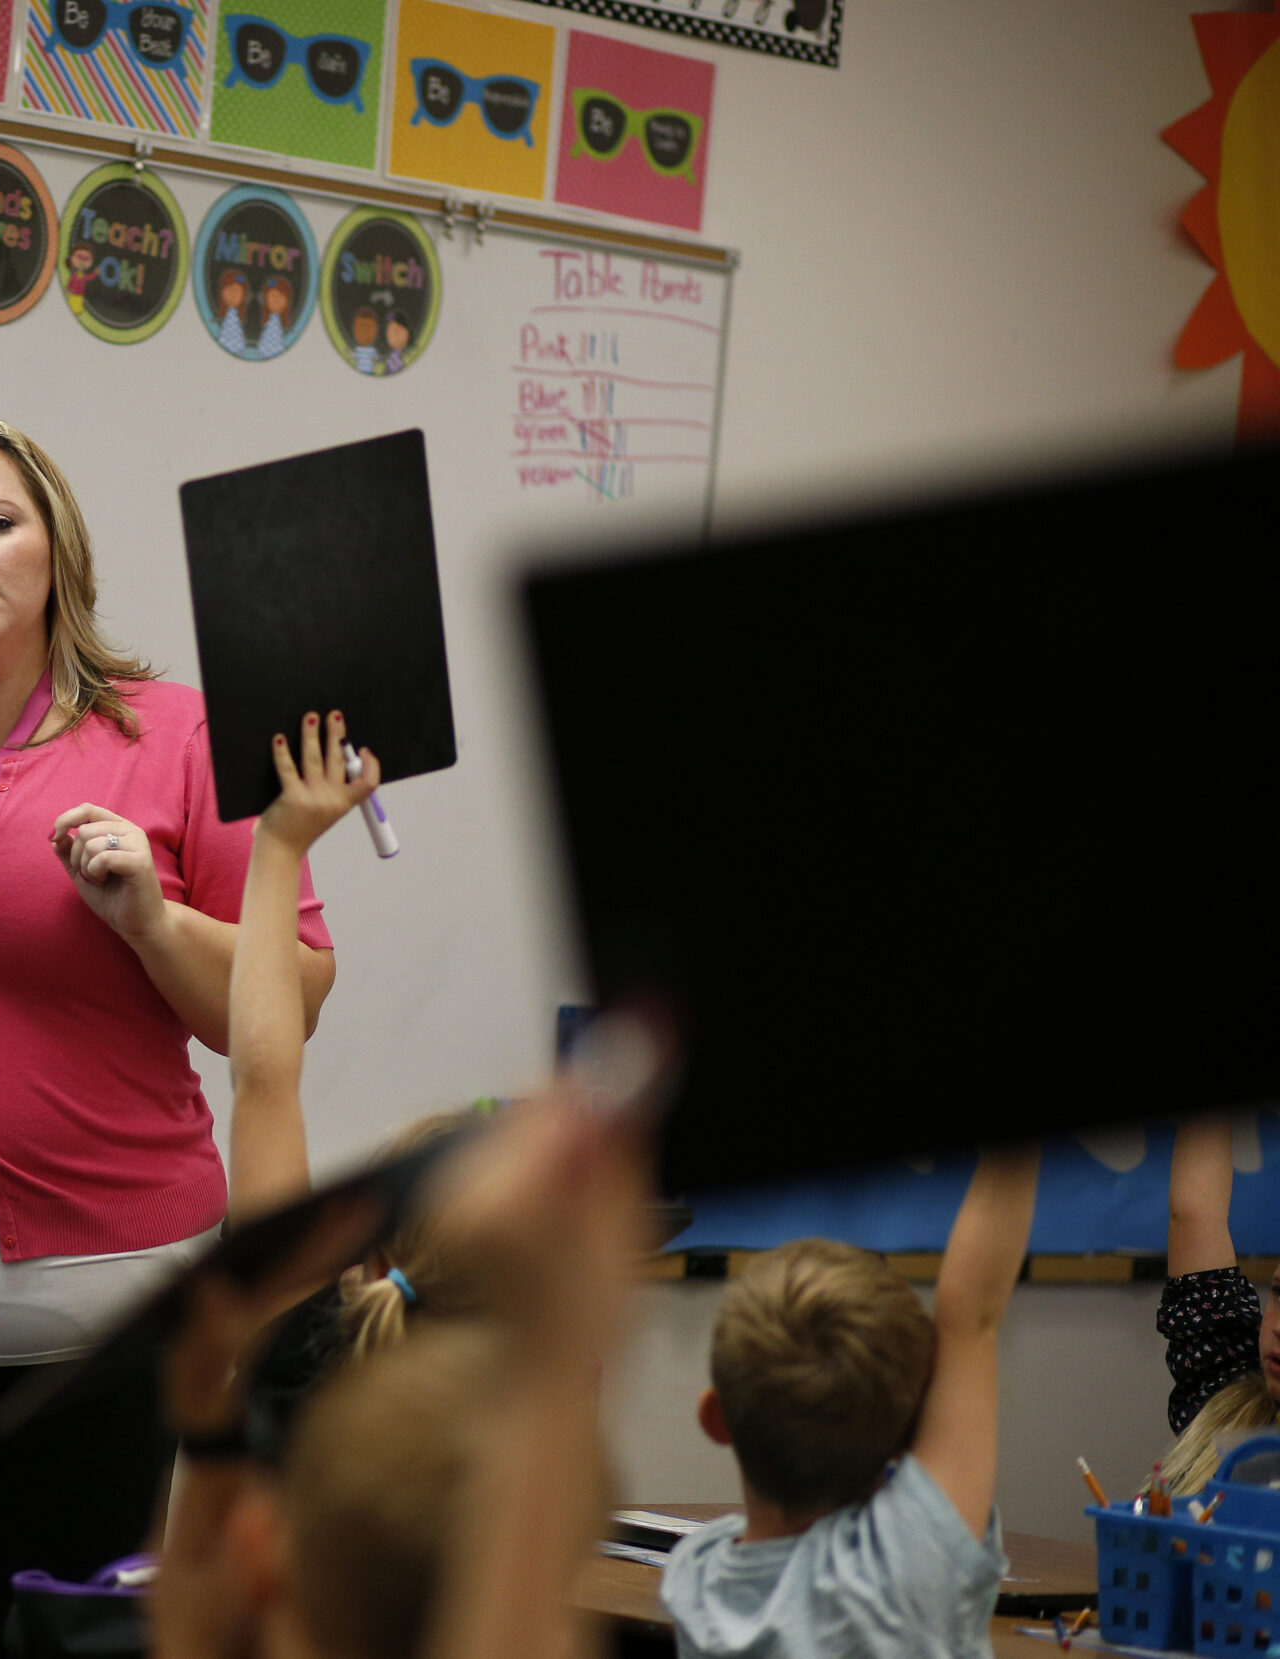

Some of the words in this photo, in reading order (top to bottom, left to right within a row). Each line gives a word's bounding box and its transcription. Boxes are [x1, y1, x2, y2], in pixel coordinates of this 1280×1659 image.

[64, 0, 89, 29] Be
[247, 39, 272, 69] Be
[428, 76, 451, 105] Be
[590, 107, 614, 137] Be
[81, 208, 175, 260] Teach?
[214, 231, 301, 271] Mirror
[340, 251, 423, 289] Switch
[539, 249, 624, 301] Table
[520, 323, 573, 364] Pink
[520, 379, 567, 412] Blue
